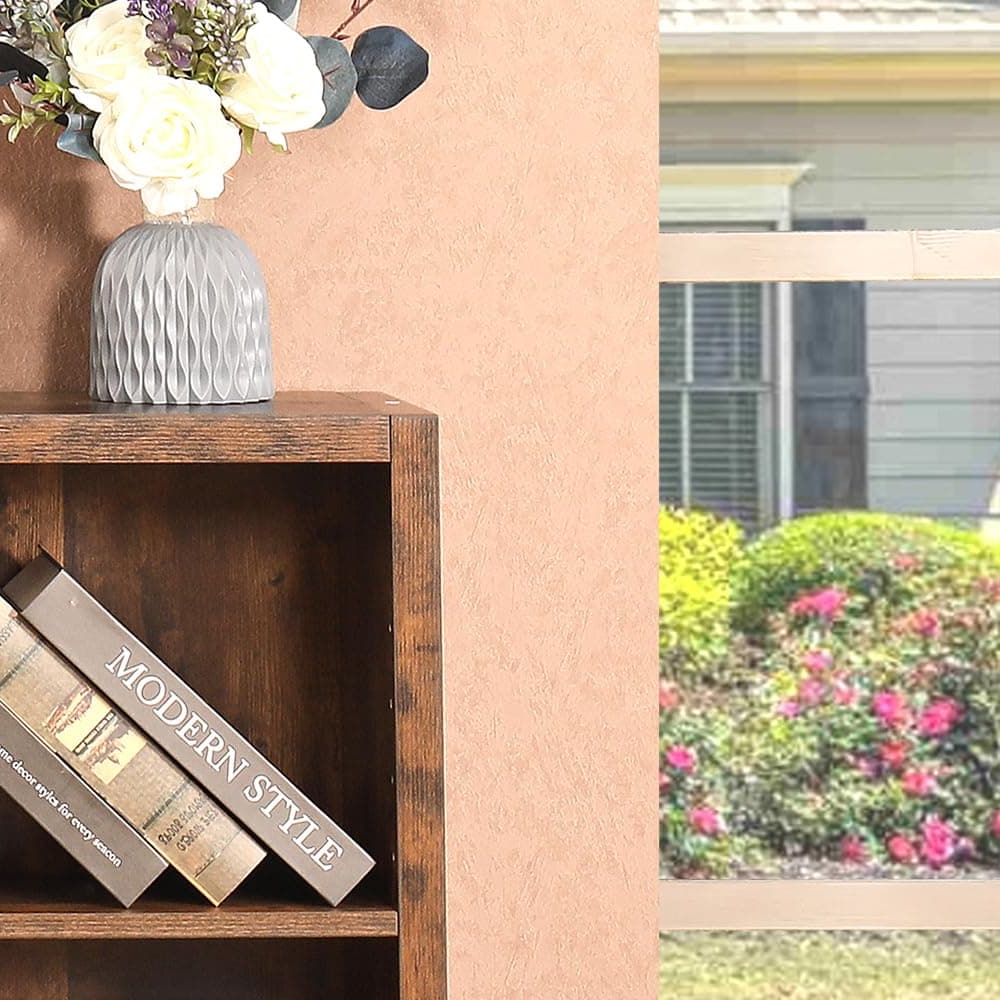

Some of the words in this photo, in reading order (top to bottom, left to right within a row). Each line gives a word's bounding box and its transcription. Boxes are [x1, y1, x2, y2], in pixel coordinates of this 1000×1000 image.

[12, 760, 38, 785] decor
[35, 783, 60, 807] styles
[58, 803, 74, 820] for
[71, 818, 96, 841] every
[105, 645, 250, 783] MODERN
[243, 774, 346, 872] STYLE
